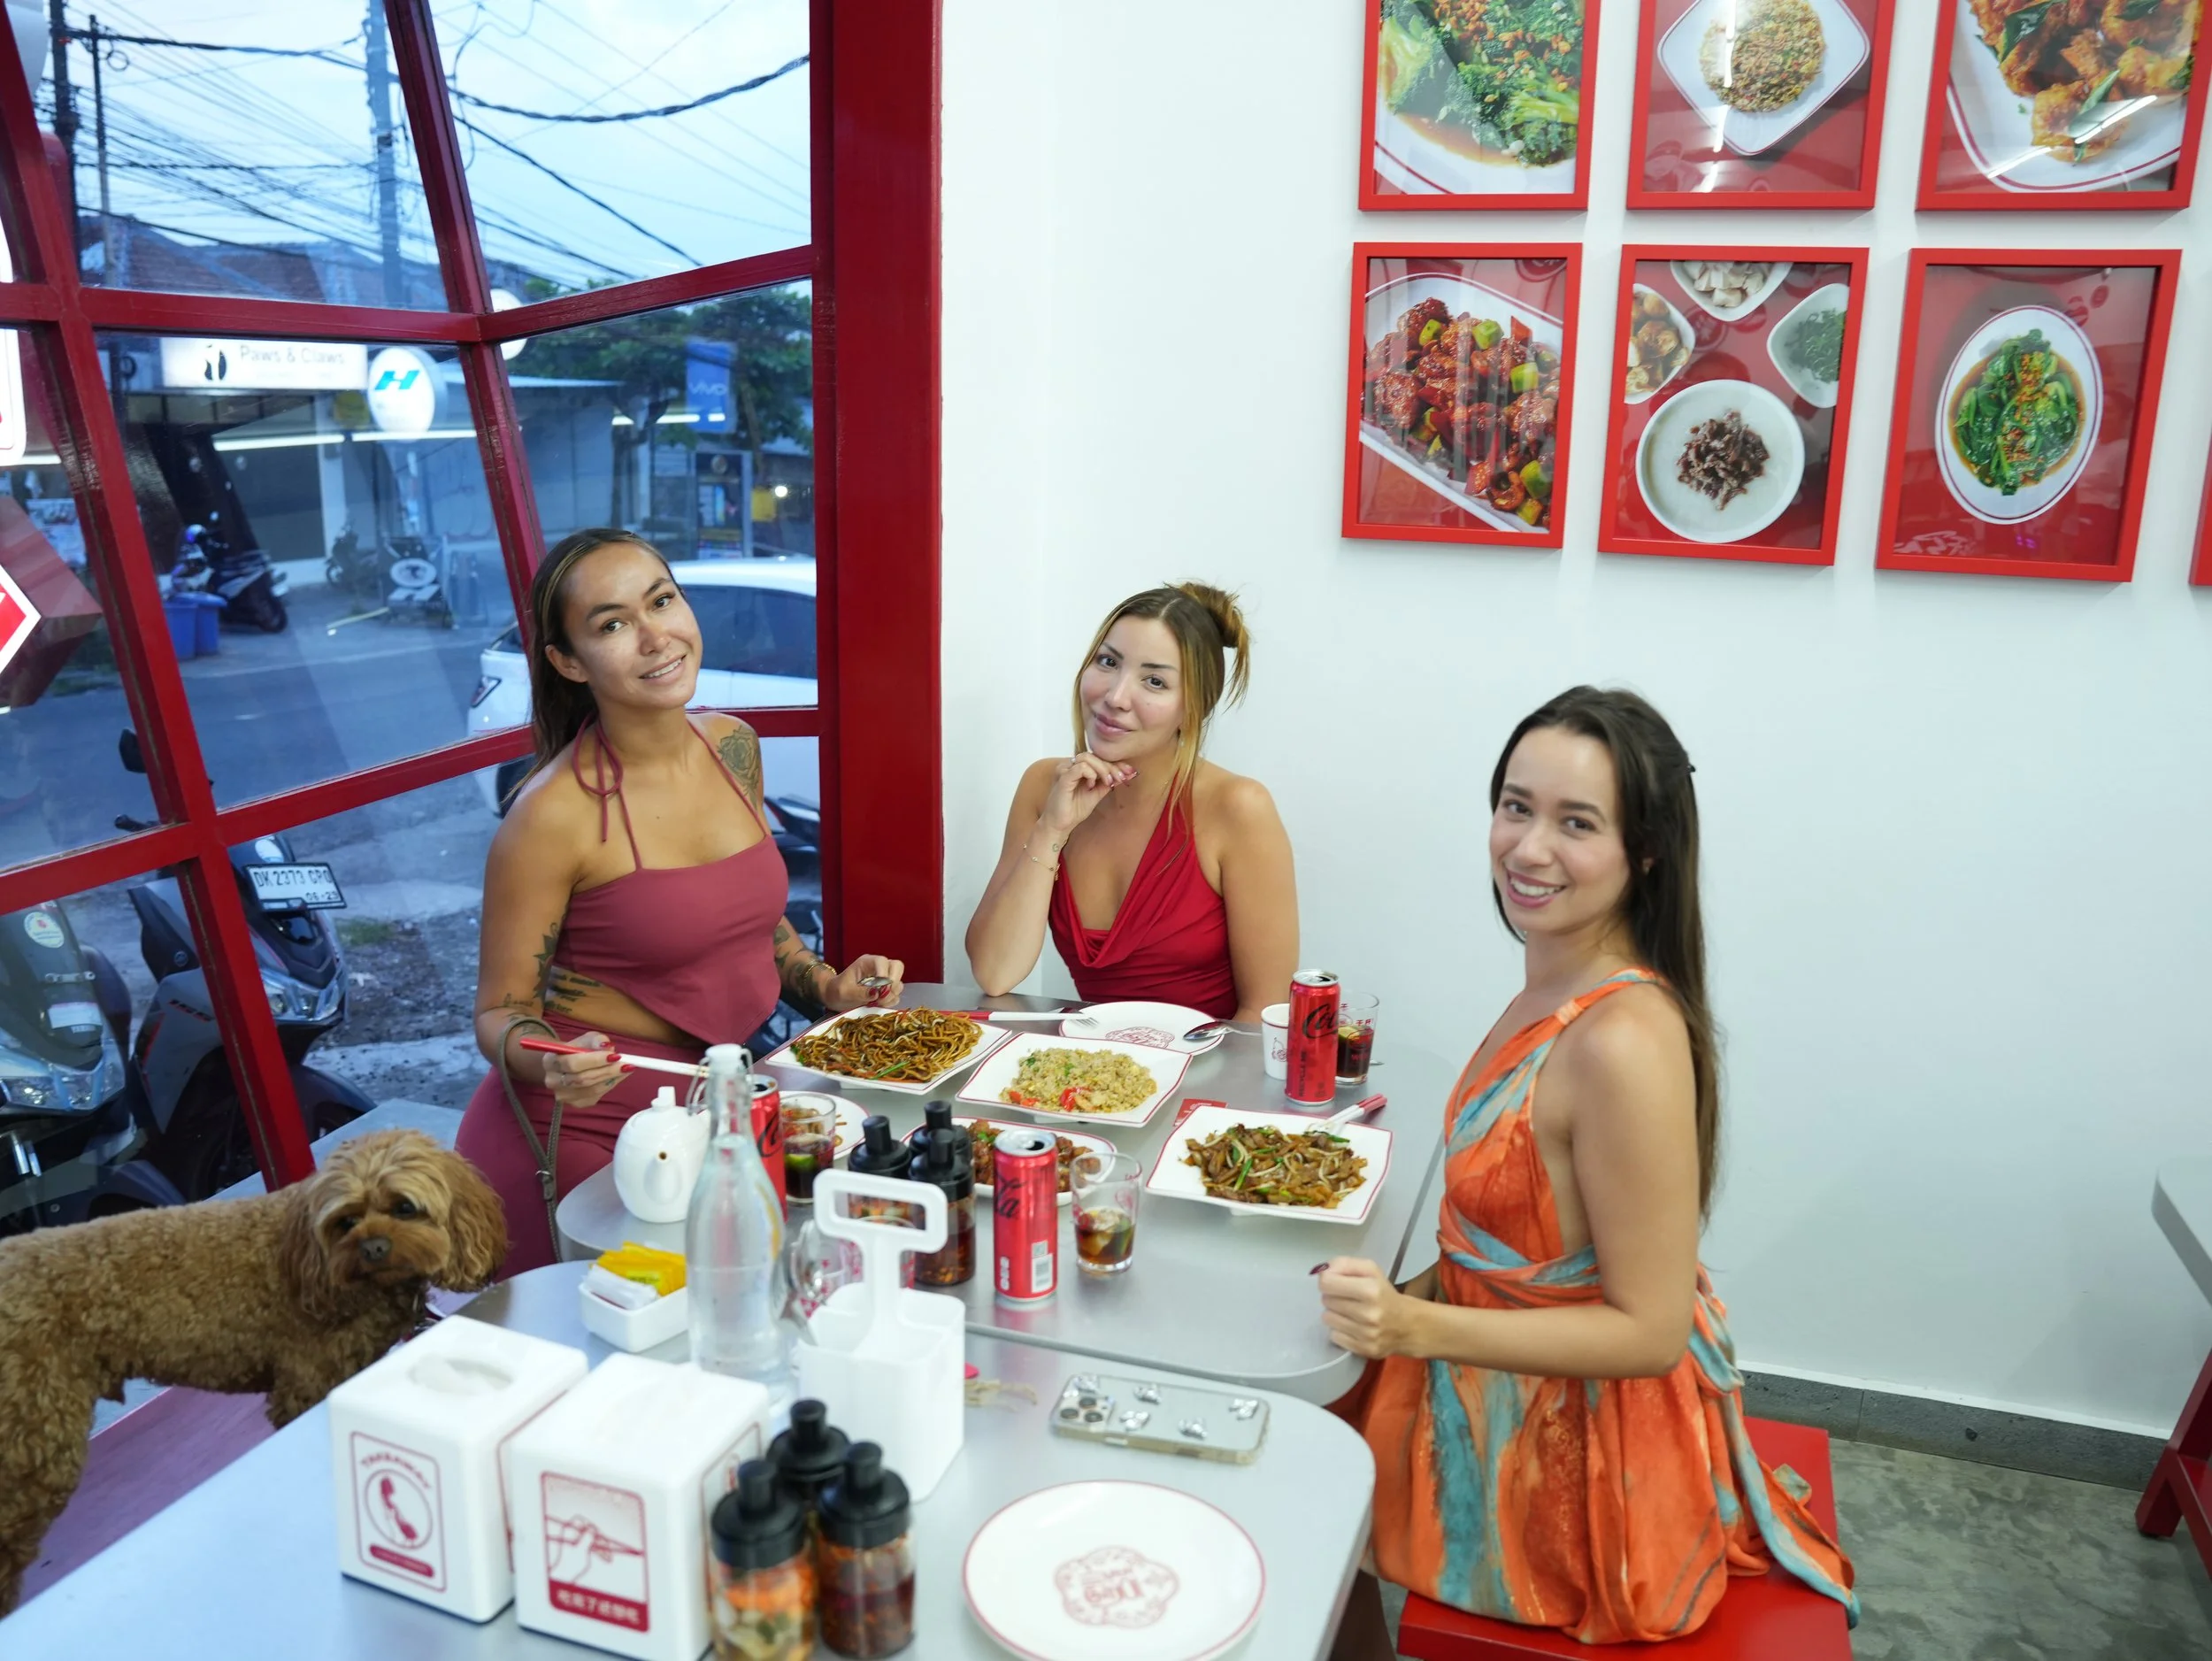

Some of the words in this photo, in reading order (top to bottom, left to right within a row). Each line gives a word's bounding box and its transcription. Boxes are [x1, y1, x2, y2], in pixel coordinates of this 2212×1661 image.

[240, 345, 281, 363] Paws
[288, 346, 296, 363] &
[301, 347, 345, 365] Claws
[253, 871, 273, 887] DK
[273, 870, 306, 886] 2373
